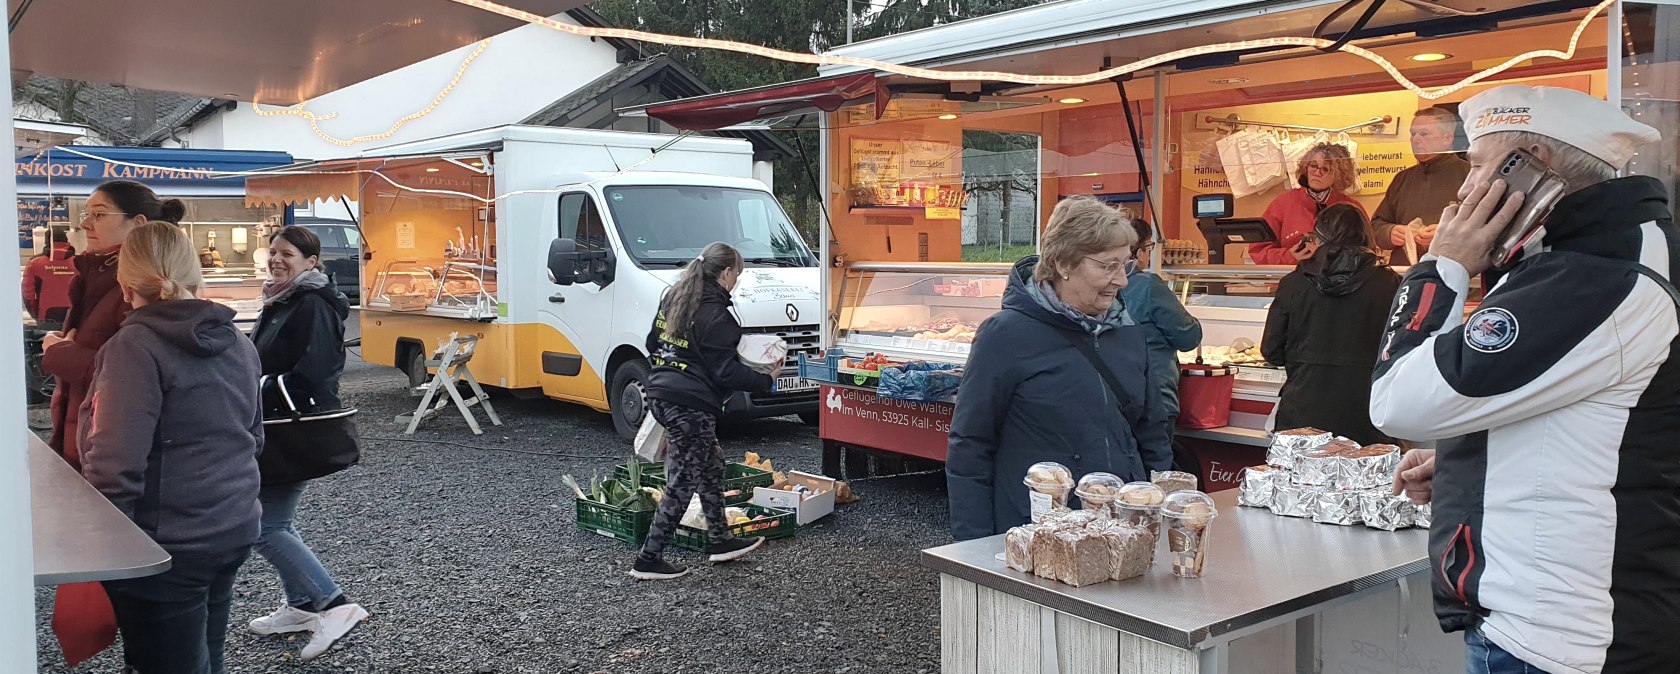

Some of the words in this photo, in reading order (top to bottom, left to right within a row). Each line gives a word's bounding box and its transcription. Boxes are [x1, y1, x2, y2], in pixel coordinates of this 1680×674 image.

[1492, 106, 1531, 115] BÄCKER
[1475, 114, 1532, 129] ZIMMER
[1362, 152, 1402, 160] leberwurst
[102, 162, 215, 180] KAMPMANN
[778, 377, 794, 390] DAU
[919, 402, 953, 416] Walter
[842, 404, 854, 416] Im
[855, 406, 880, 423] Venn,
[882, 411, 909, 426] 53925
[911, 415, 933, 430] Kall-
